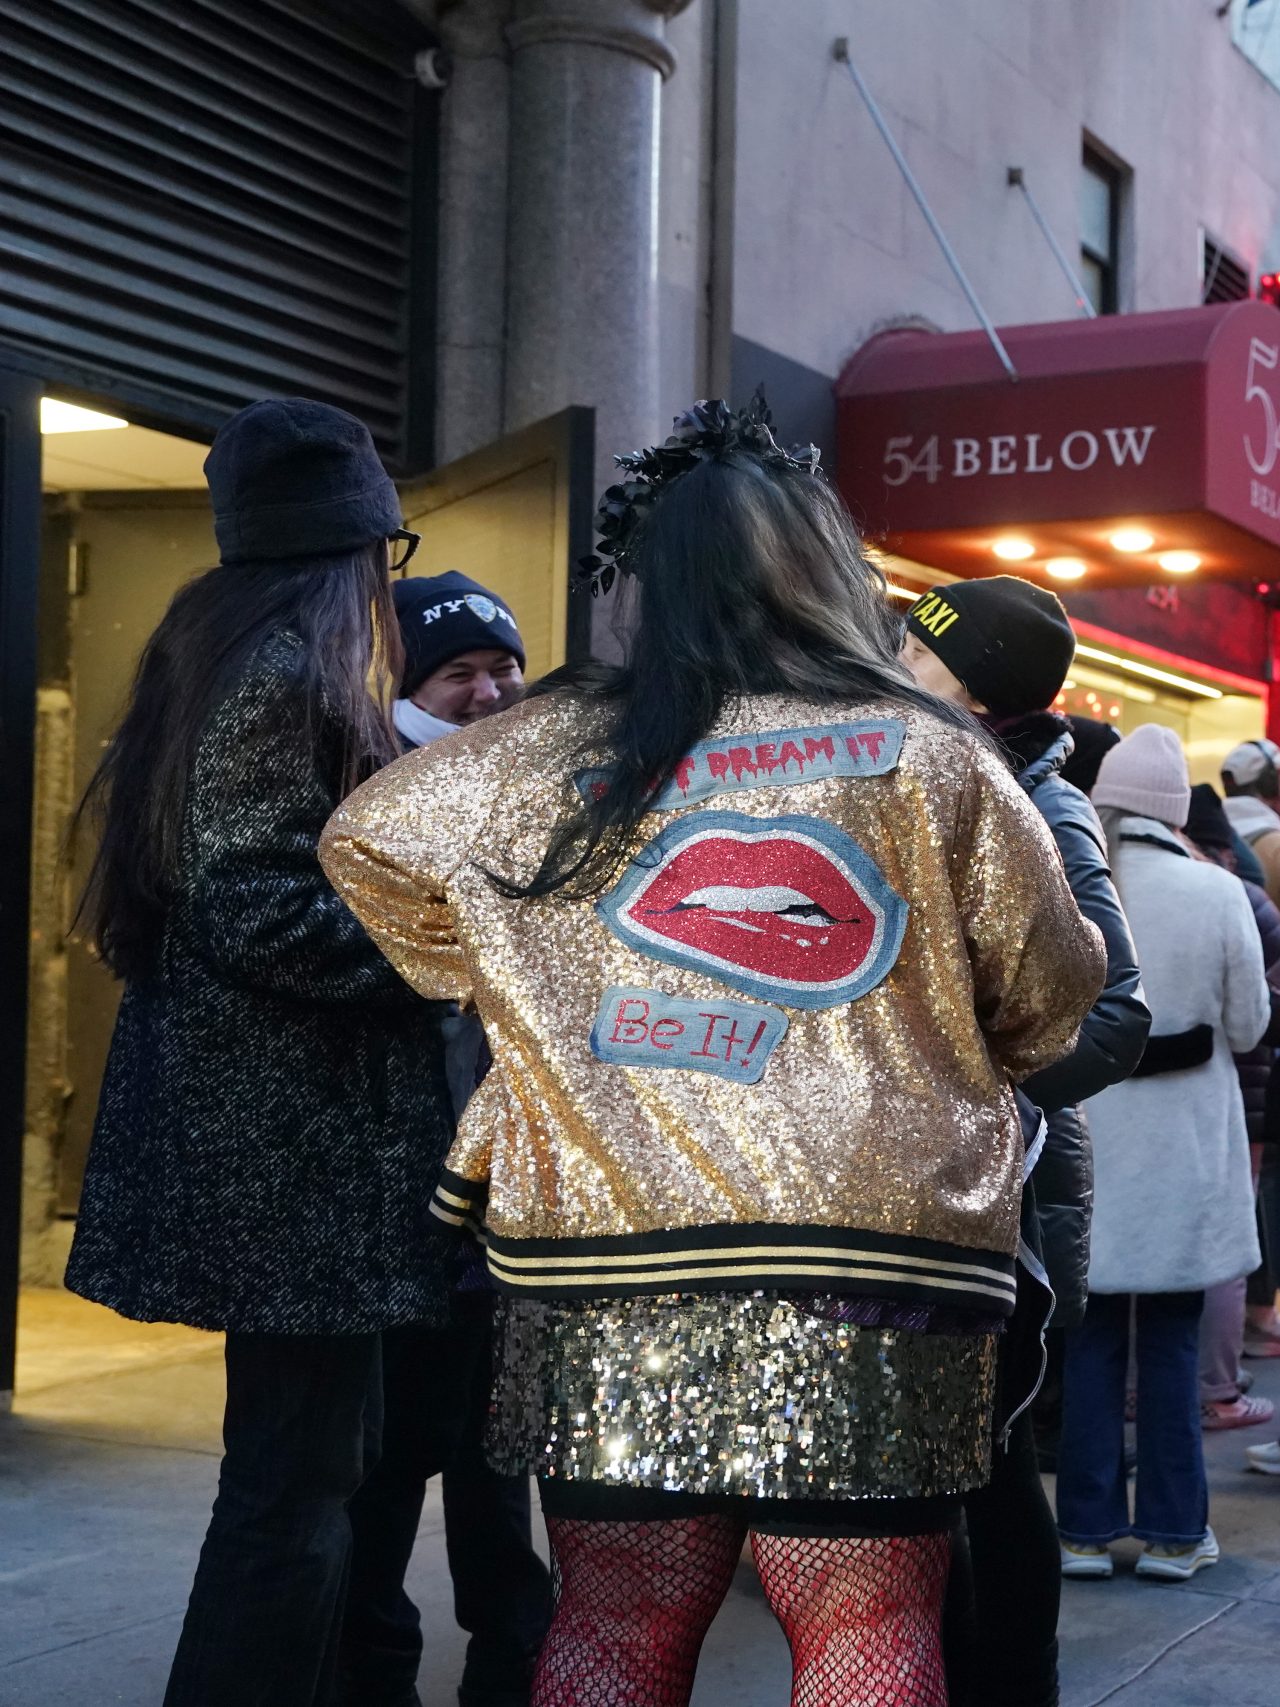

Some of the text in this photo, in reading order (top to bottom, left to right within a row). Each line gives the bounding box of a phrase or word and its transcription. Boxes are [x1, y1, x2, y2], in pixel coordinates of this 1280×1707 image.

[883, 426, 1156, 486] 54 BELOW
[912, 591, 960, 638] TAXI
[706, 734, 836, 783] DREAM
[845, 731, 887, 766] IT
[608, 999, 767, 1069] Be It!
